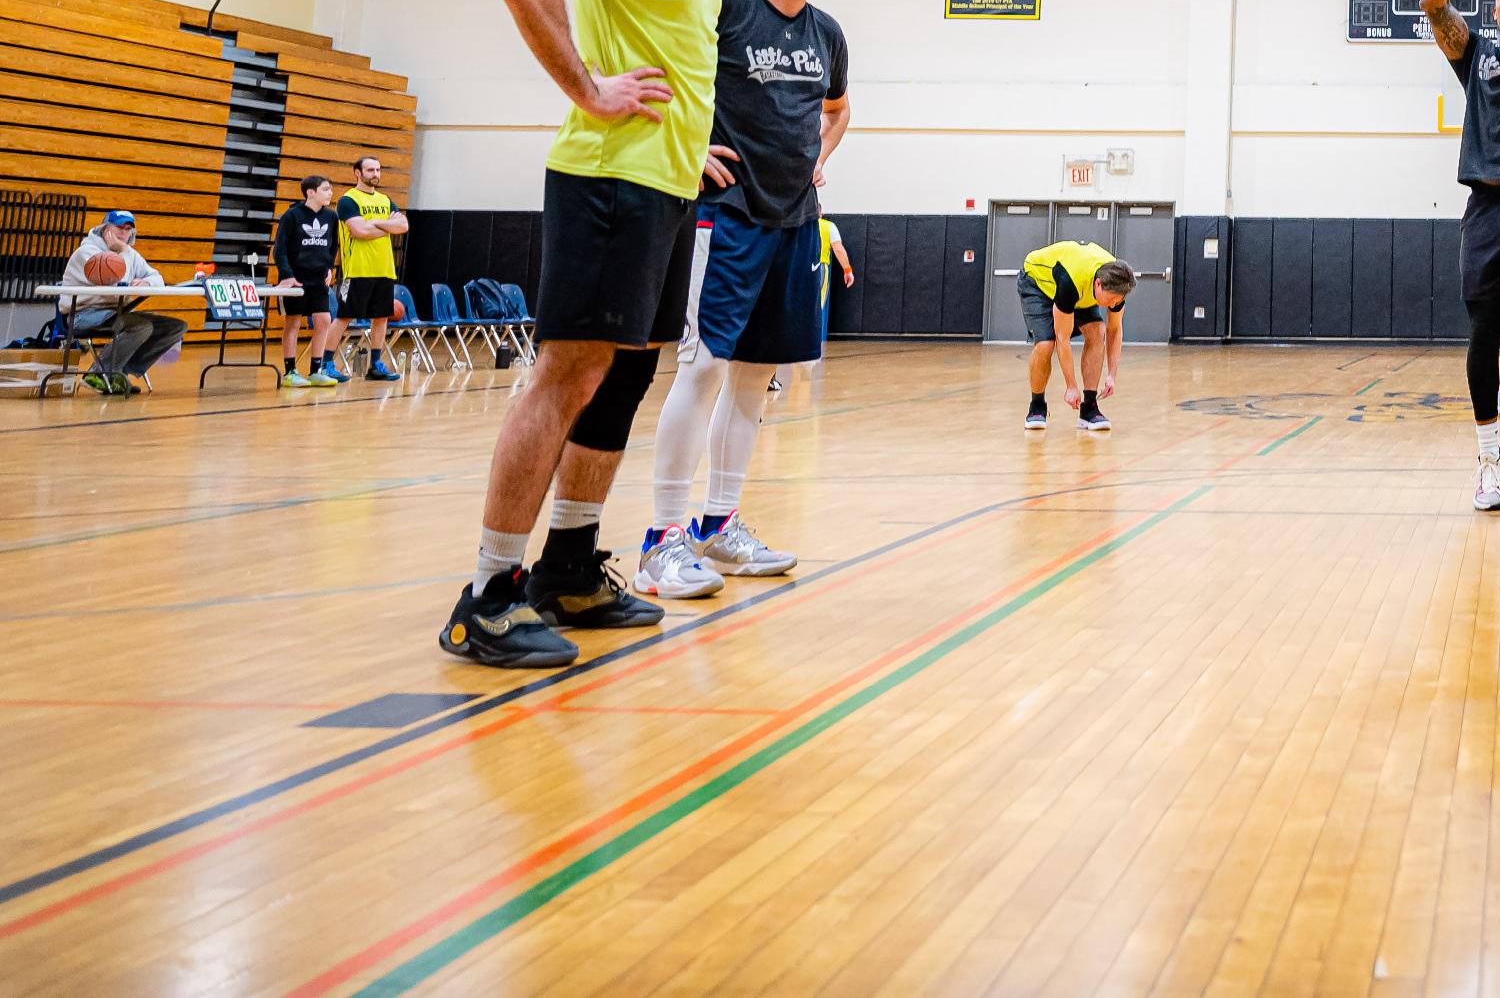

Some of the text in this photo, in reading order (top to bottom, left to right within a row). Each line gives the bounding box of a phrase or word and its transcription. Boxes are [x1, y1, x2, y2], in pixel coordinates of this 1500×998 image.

[1366, 27, 1392, 37] BONUS
[746, 45, 824, 74] Little Pub
[1071, 168, 1090, 184] EXIT
[302, 238, 328, 247] adidas
[211, 284, 227, 302] 28
[242, 285, 258, 302] 23
